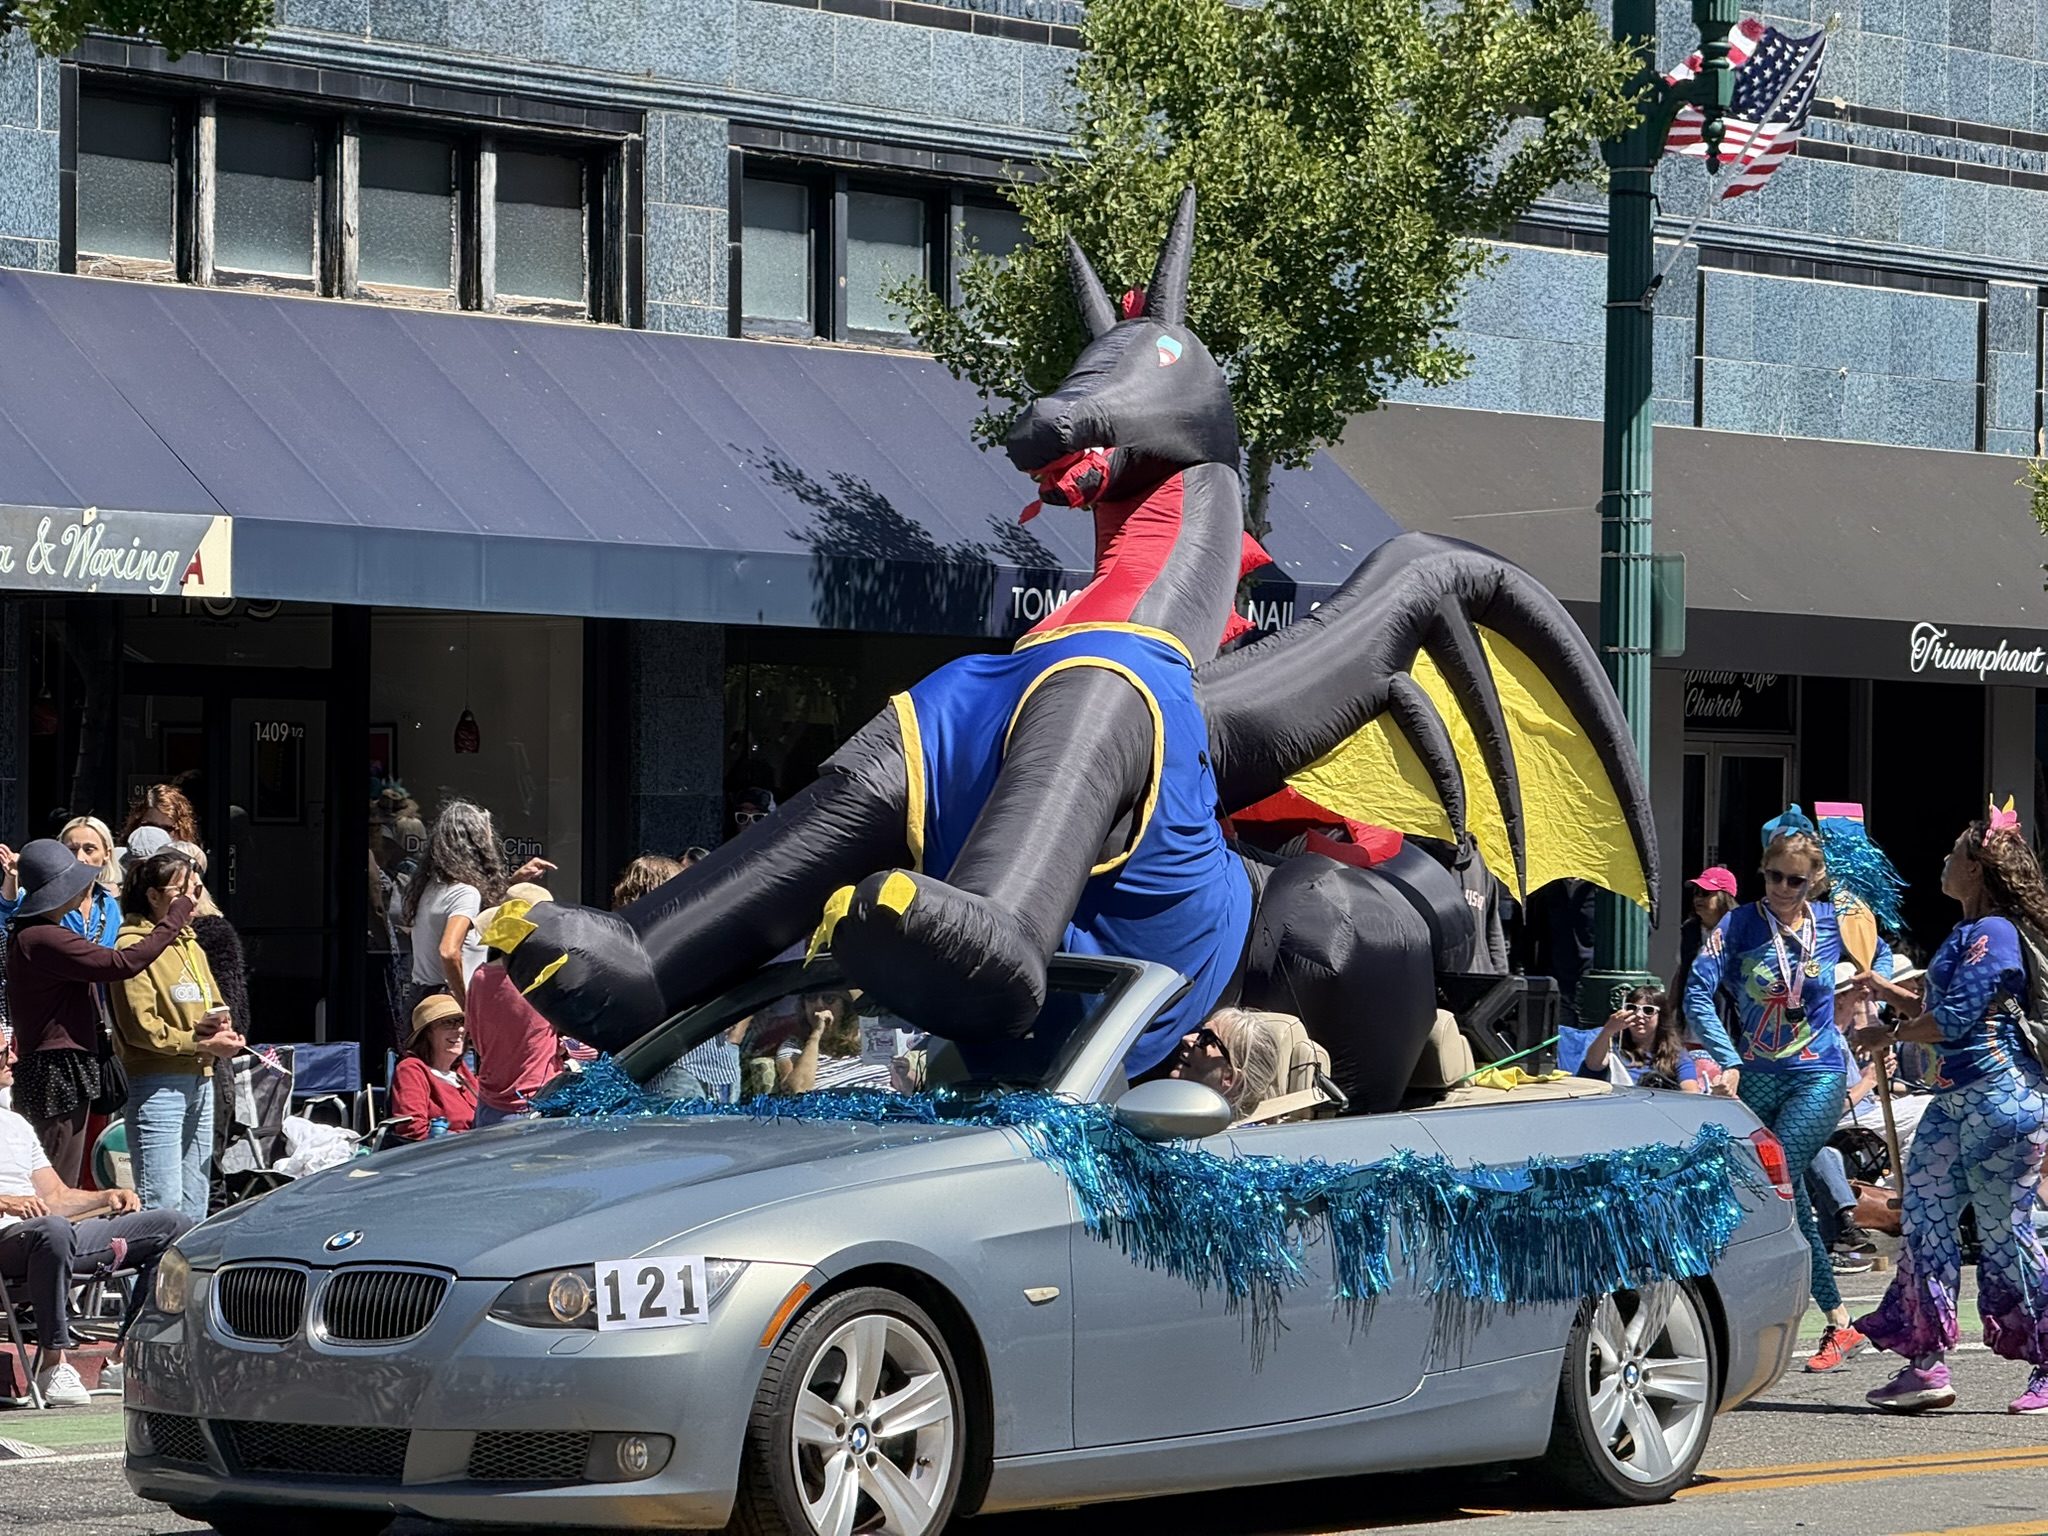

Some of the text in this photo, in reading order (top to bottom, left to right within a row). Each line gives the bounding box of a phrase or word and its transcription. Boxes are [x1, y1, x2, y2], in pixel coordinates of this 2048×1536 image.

[26, 516, 56, 575] &
[61, 523, 180, 594] Waxing
[1911, 622, 2046, 681] Triumphant
[1685, 687, 1743, 717] Church
[255, 722, 304, 742] 1409 1/2
[503, 838, 542, 855] Chin
[604, 1265, 699, 1321] 121
